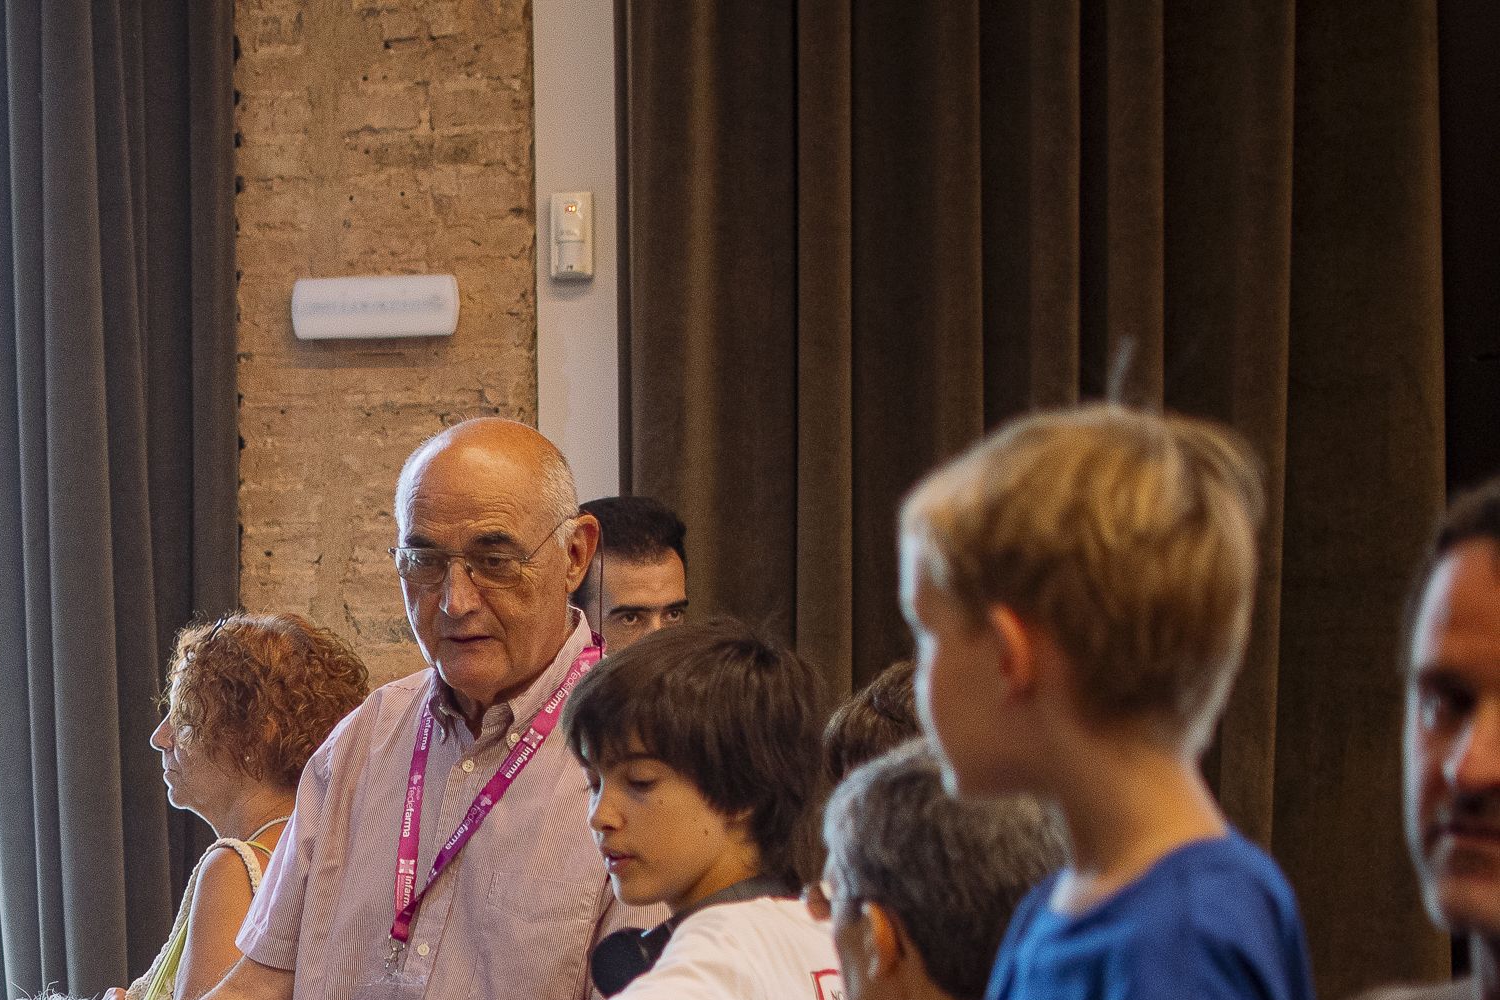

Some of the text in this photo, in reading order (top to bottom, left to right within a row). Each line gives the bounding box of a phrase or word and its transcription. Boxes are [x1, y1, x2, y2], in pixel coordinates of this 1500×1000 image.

[545, 669, 581, 714] fedefarma
[402, 786, 417, 838] fedefarma
[445, 804, 480, 850] fedefarma
[403, 875, 414, 908] infarm
